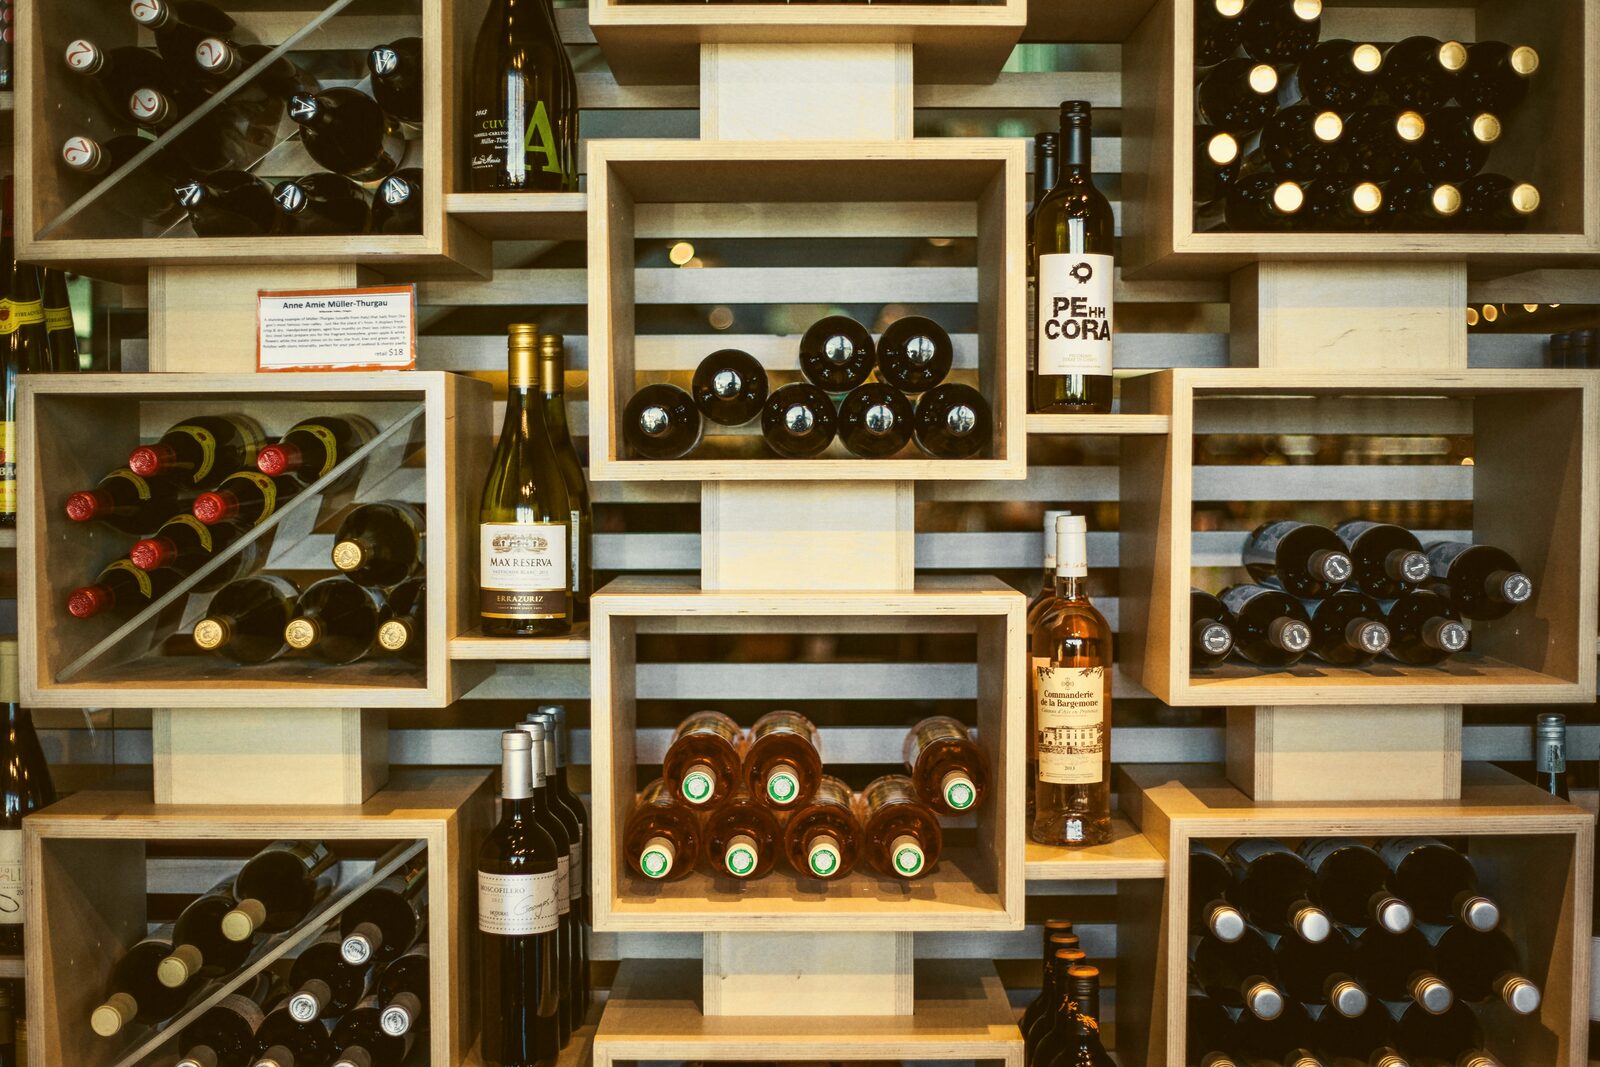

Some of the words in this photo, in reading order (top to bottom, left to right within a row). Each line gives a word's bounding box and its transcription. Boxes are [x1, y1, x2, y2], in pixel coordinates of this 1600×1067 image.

[67, 41, 92, 67] 2
[197, 42, 222, 66] 2
[373, 48, 393, 75] A
[132, 95, 157, 112] 2
[290, 95, 317, 119] A
[524, 100, 562, 174] A
[63, 139, 89, 162] 2
[174, 183, 202, 207] A
[274, 184, 300, 208] A
[384, 175, 410, 205] A
[328, 299, 388, 309] Müller-Thurgau
[1044, 319, 1111, 341] CORA
[388, 348, 404, 357] $18
[490, 558, 511, 567] MAX
[513, 558, 553, 567] RESERVA
[1041, 698, 1048, 706] de
[1049, 698, 1056, 707] la
[1057, 699, 1099, 709] Bargemone
[1043, 690, 1094, 699] Commanderie
